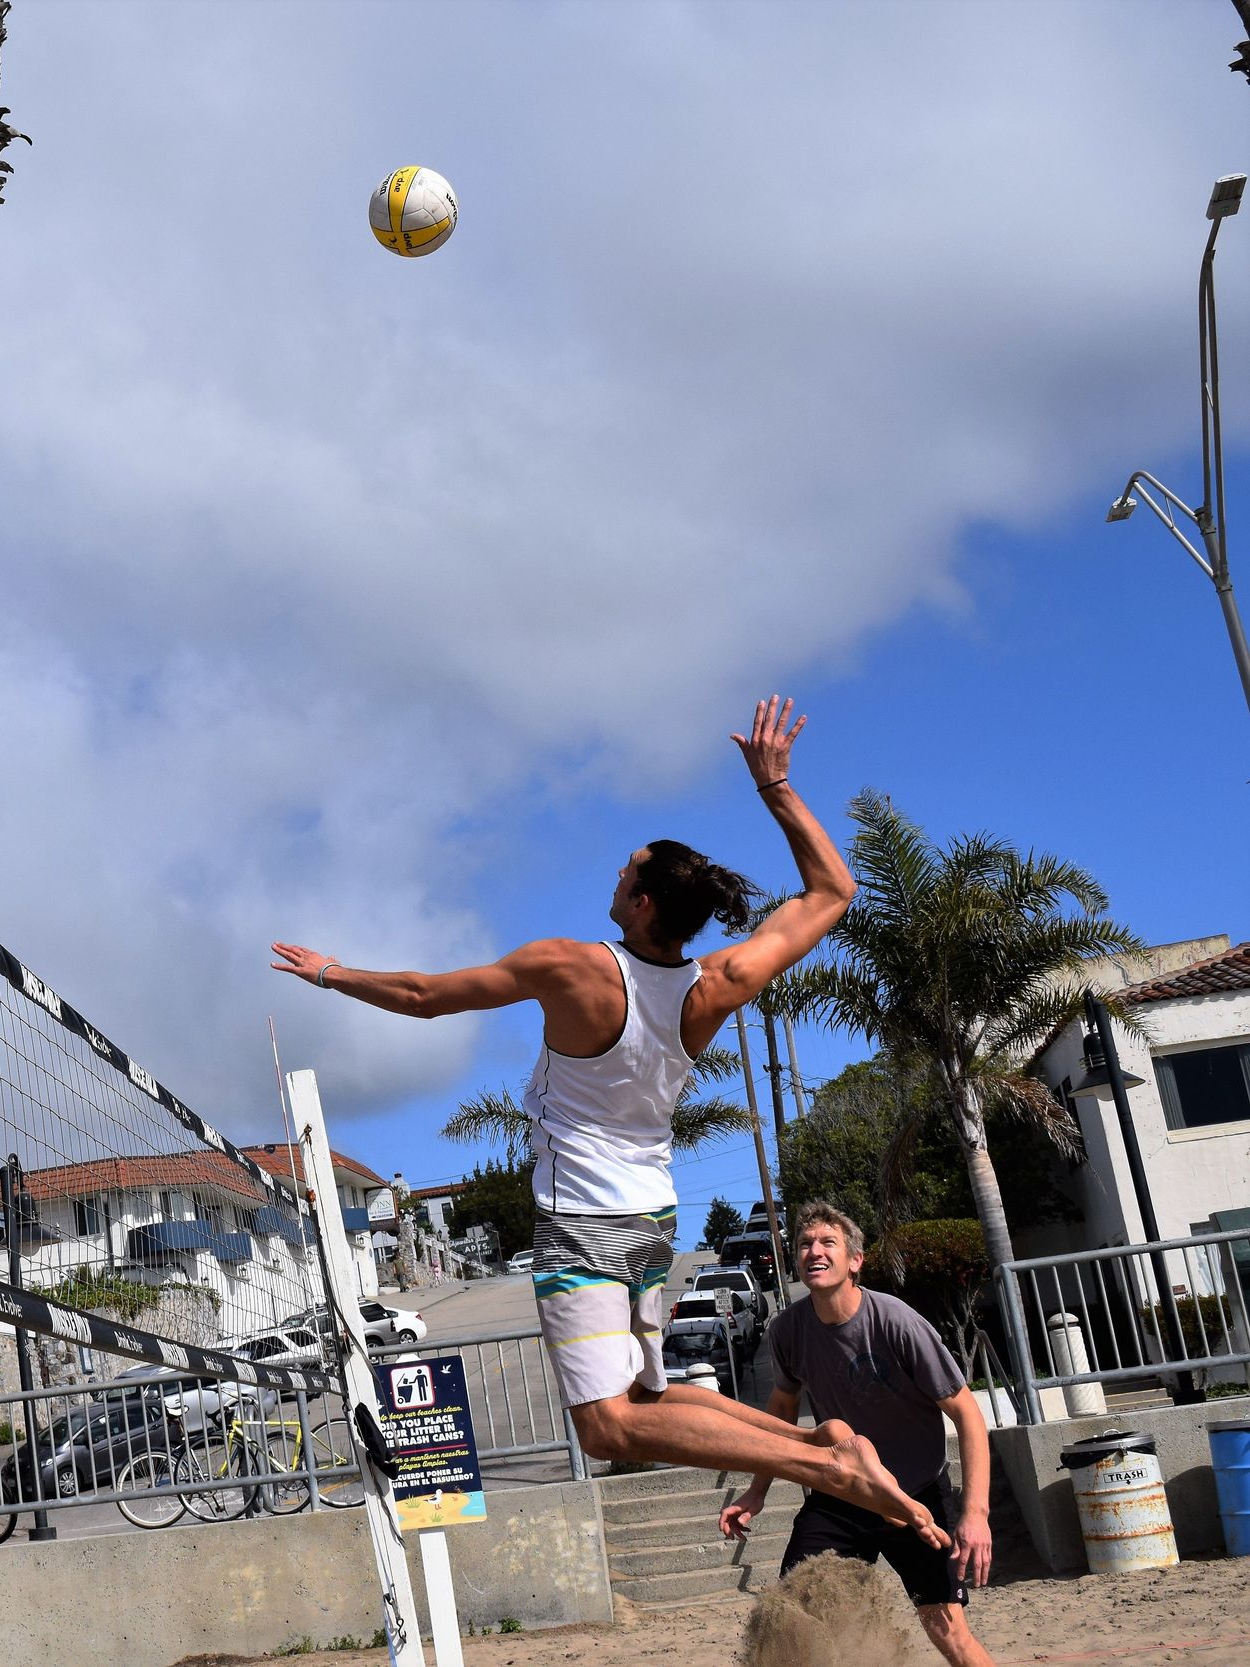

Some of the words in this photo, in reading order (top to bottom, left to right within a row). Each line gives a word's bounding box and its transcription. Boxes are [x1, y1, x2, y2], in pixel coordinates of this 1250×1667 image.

[400, 1418, 421, 1429] YOU
[424, 1414, 454, 1426] PLACE
[410, 1425, 441, 1436] LITTER
[444, 1422, 456, 1432] IN
[398, 1434, 430, 1447] TRASH
[432, 1430, 464, 1442] CANS?
[396, 1471, 425, 1481] CUERDE
[426, 1468, 452, 1478] PONER
[1107, 1469, 1144, 1482] TRASH
[392, 1481, 409, 1489] URA
